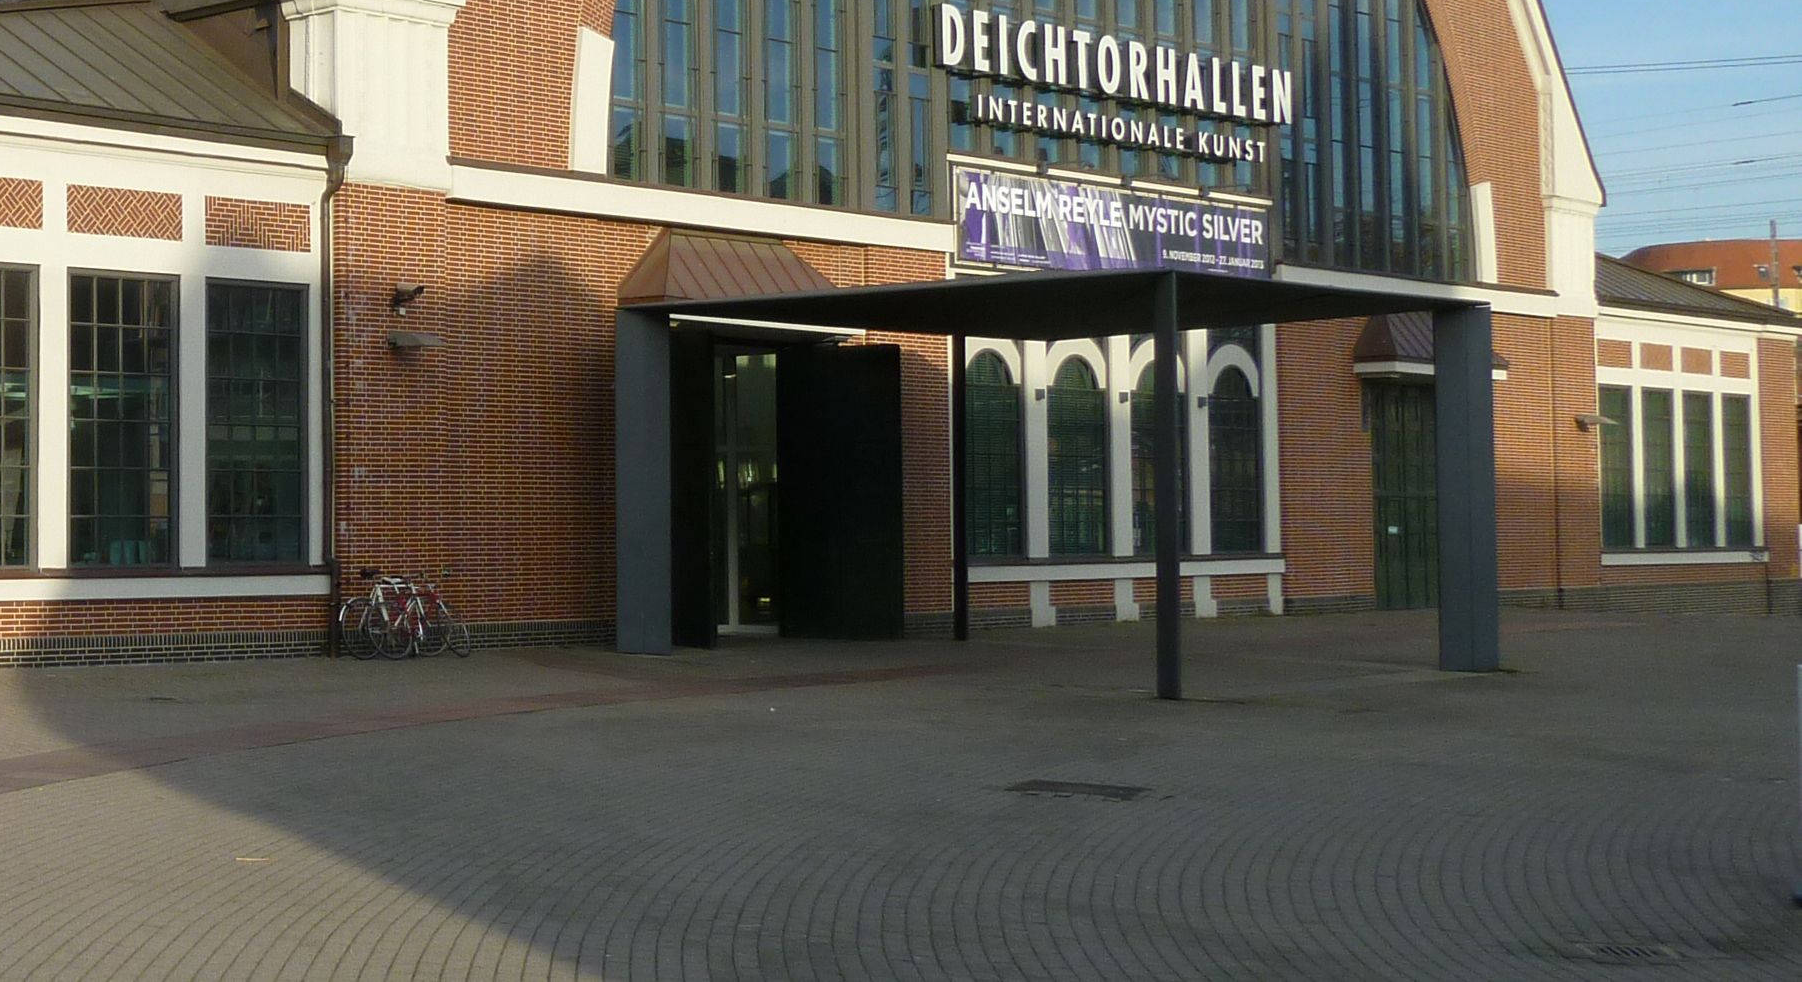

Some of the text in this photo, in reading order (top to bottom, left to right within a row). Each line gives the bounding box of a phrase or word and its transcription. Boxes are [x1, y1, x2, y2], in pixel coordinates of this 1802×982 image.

[942, 3, 1293, 124] DEICHTORHALLEN
[977, 94, 1266, 163] INTERNATIONALE KUNST
[965, 181, 1264, 245] ANSELM REYLE MYSTIC SILVER
